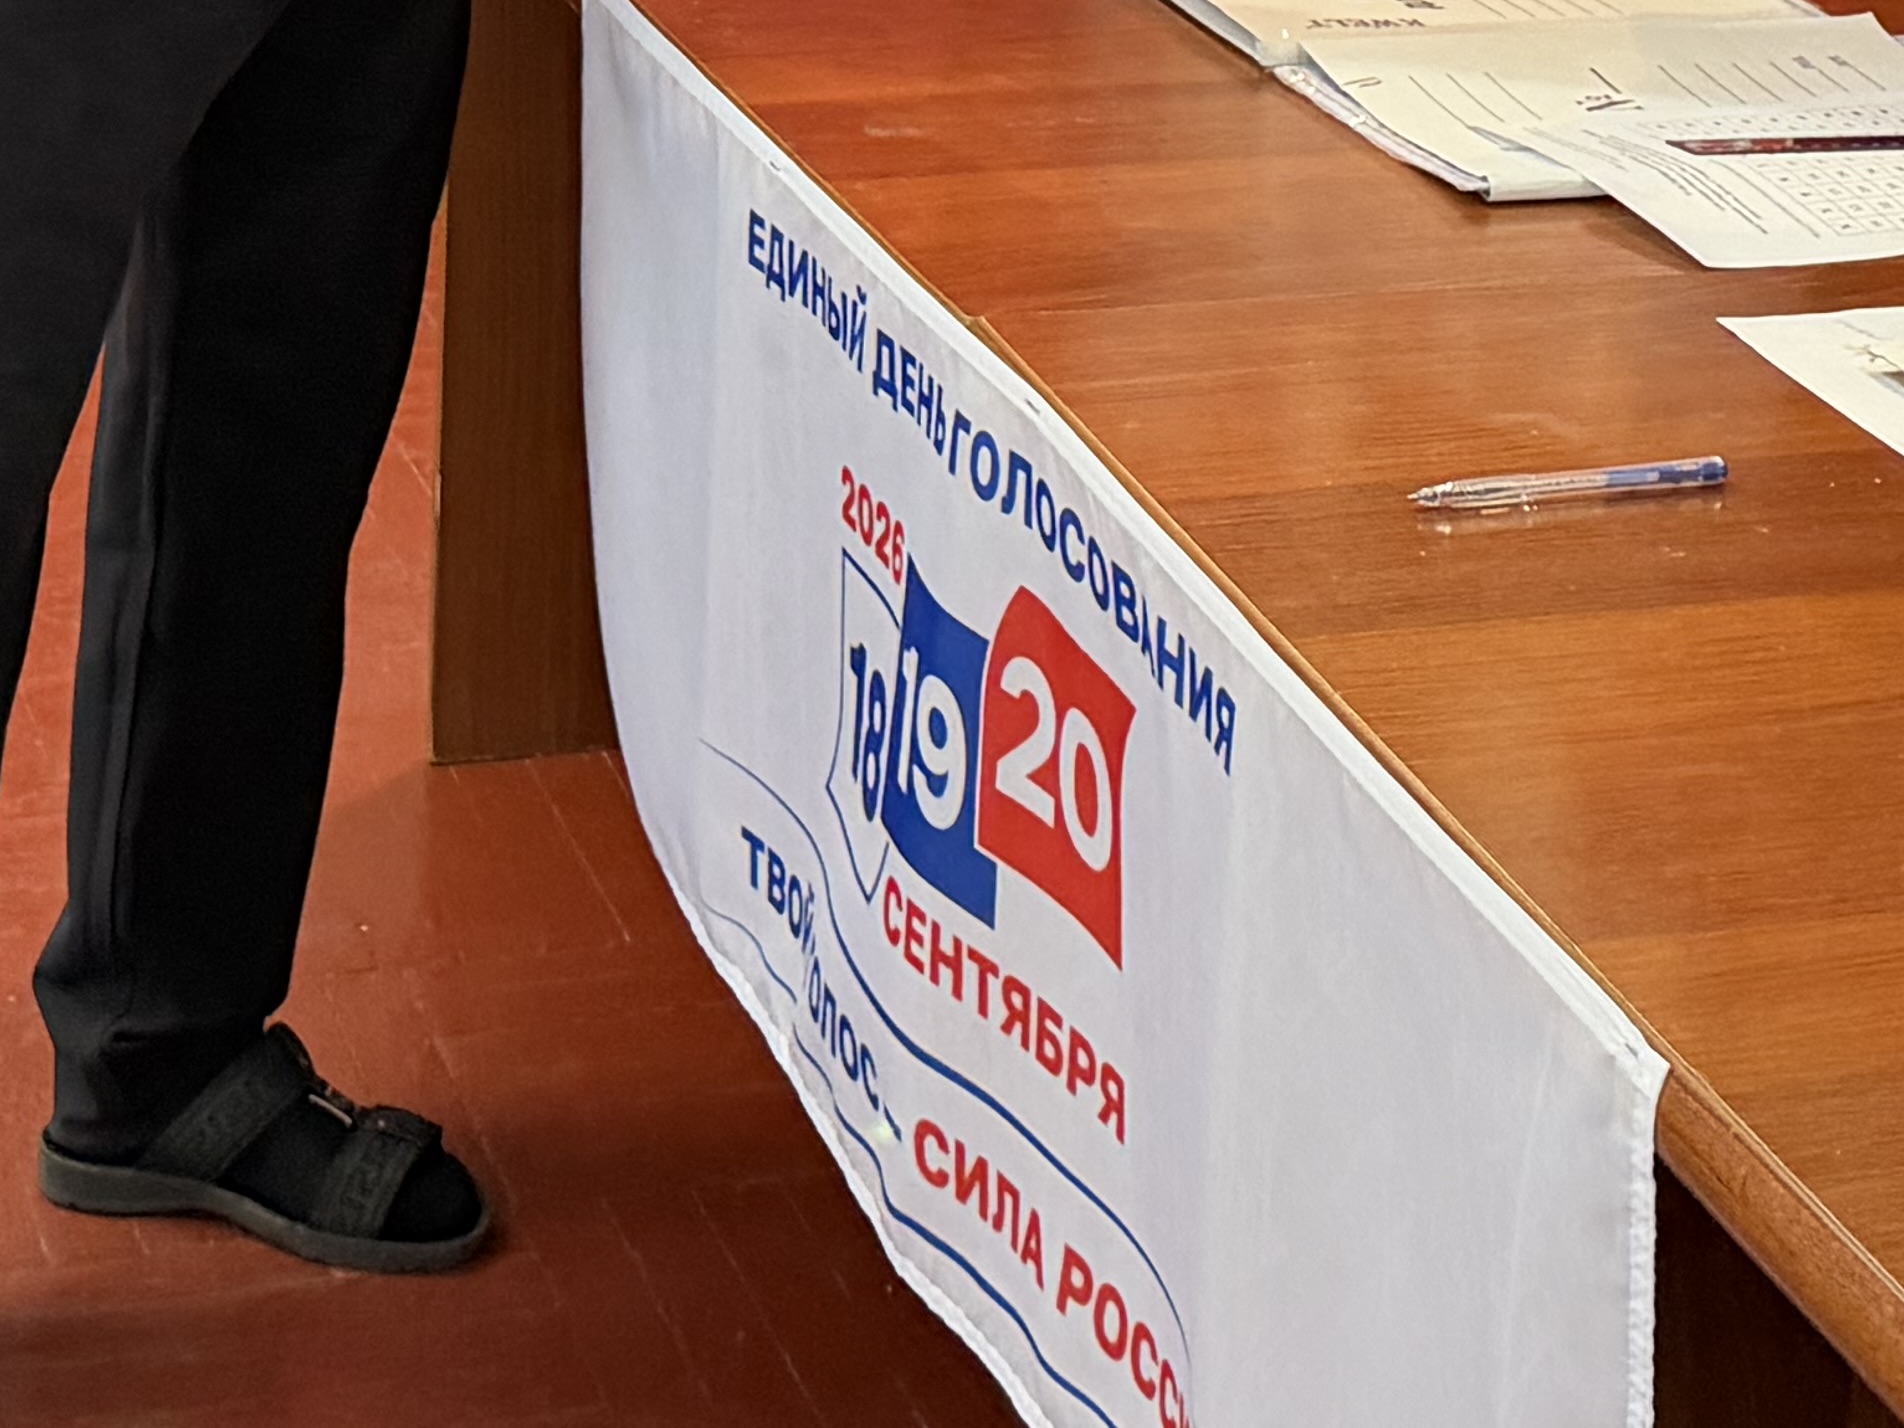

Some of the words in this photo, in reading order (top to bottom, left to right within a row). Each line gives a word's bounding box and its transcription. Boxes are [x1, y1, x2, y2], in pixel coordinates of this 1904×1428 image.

[748, 208, 872, 374] ЕДИНЫЙ
[872, 328, 947, 454] ДЕНЬ
[840, 464, 905, 585] 2026
[849, 642, 888, 823] 18
[897, 644, 967, 831] 19
[996, 655, 1113, 872] 20
[883, 875, 1126, 1145] СЕНТЯБРЯ
[914, 1117, 1045, 1291] СИЛА
